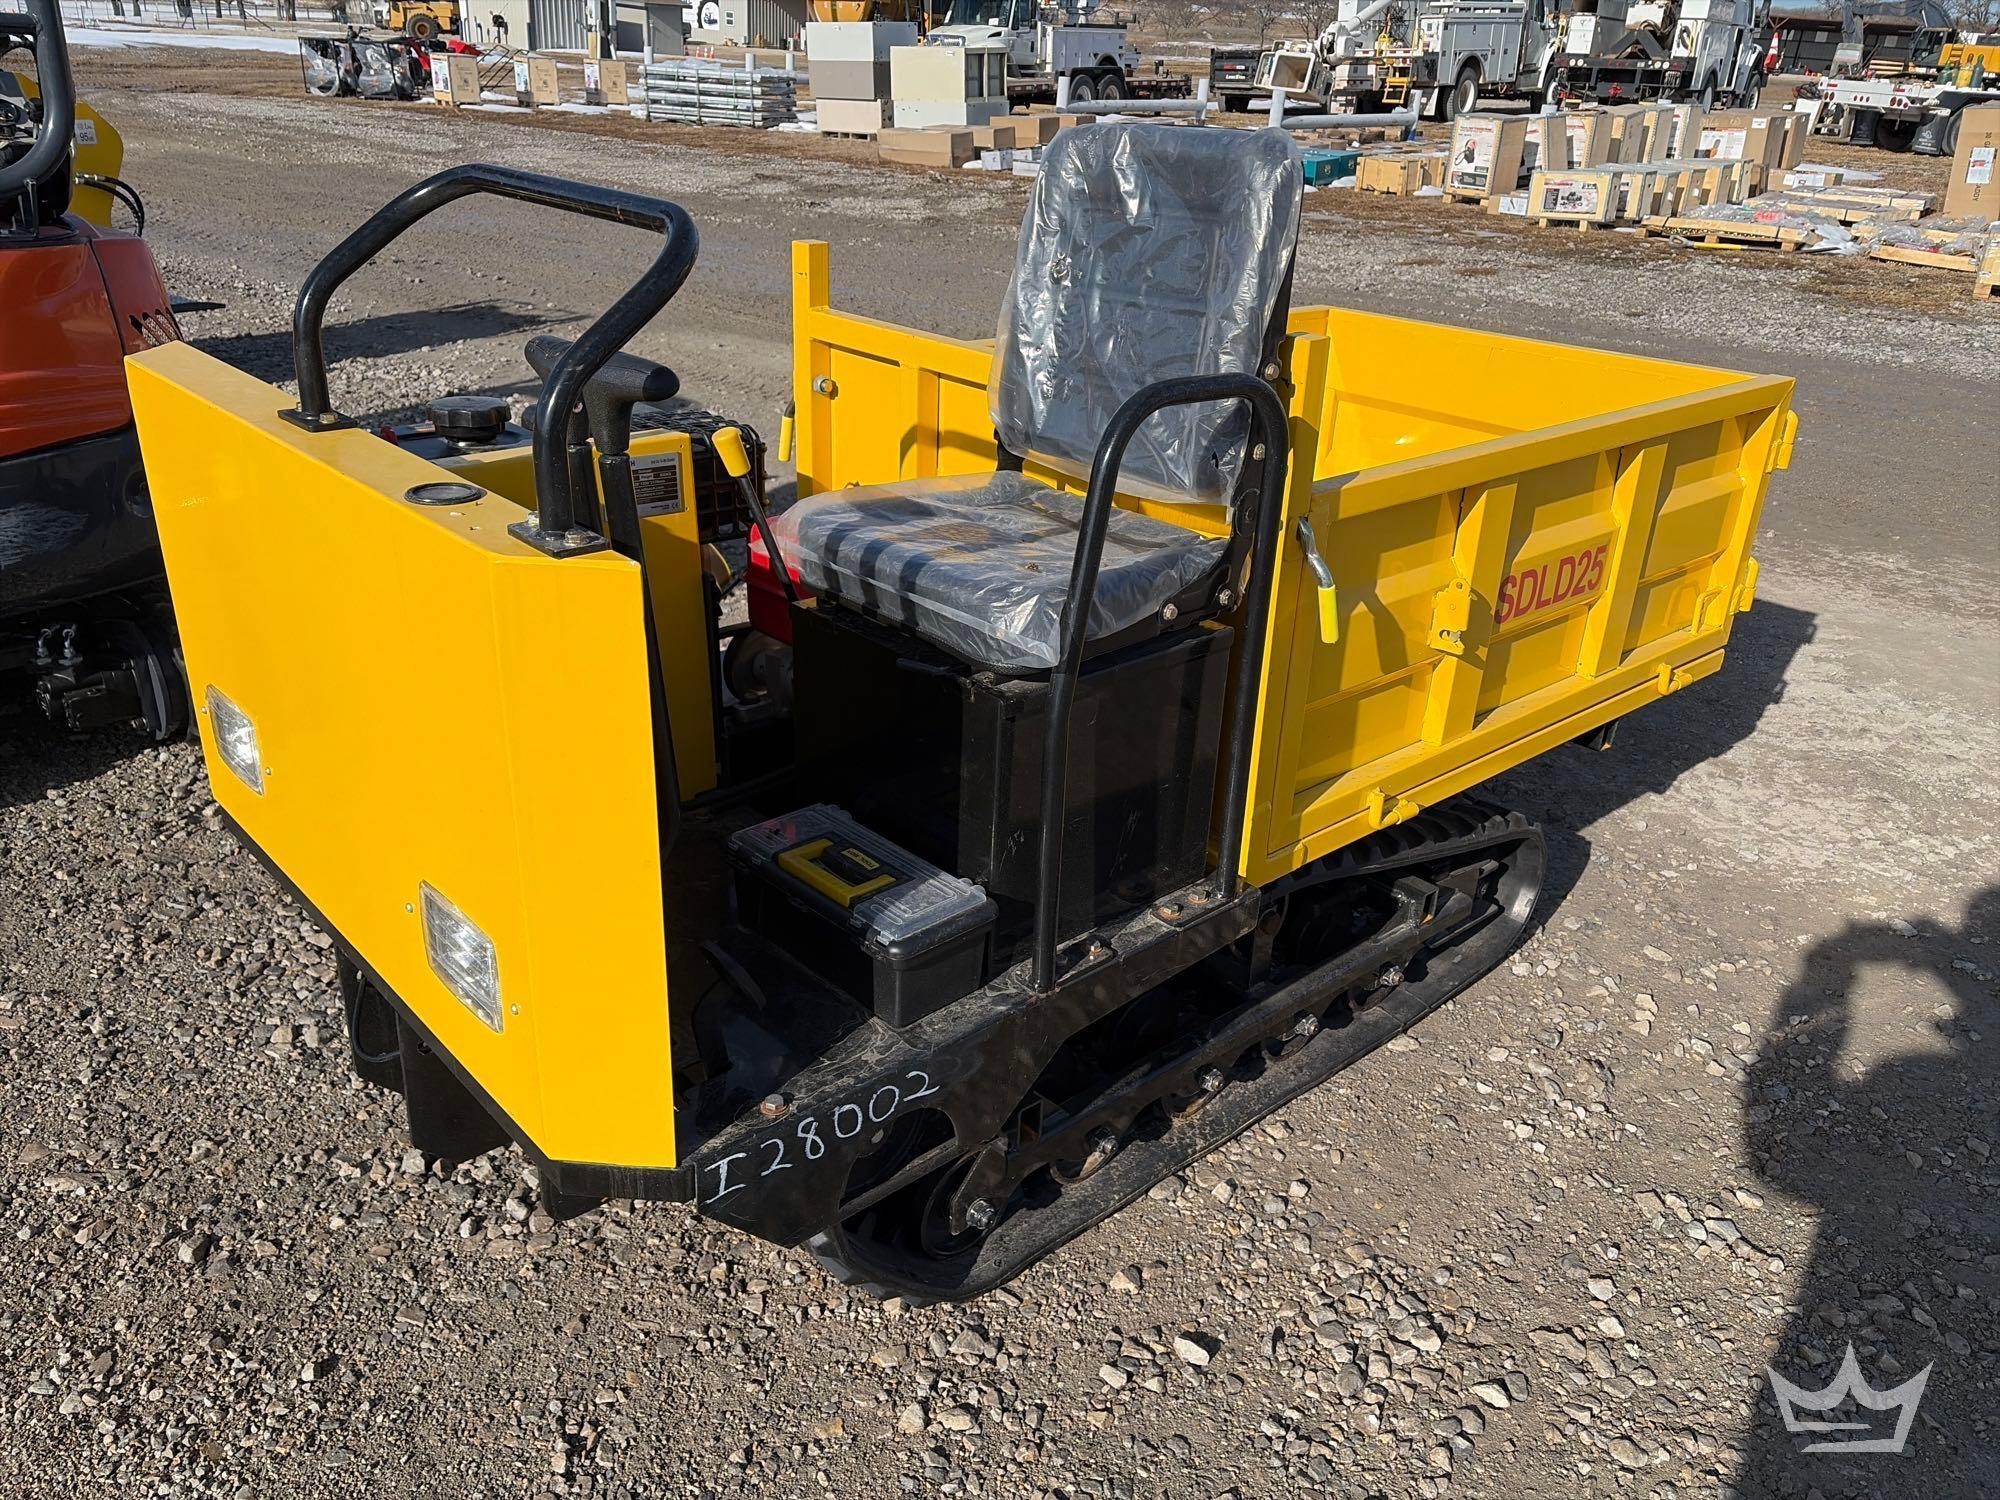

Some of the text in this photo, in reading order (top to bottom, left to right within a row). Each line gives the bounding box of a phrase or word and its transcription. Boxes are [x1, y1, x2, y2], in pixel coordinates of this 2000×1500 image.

[79, 132, 88, 142] 95
[1493, 545, 1608, 625] SDLD25
[704, 1071, 940, 1204] I28002
